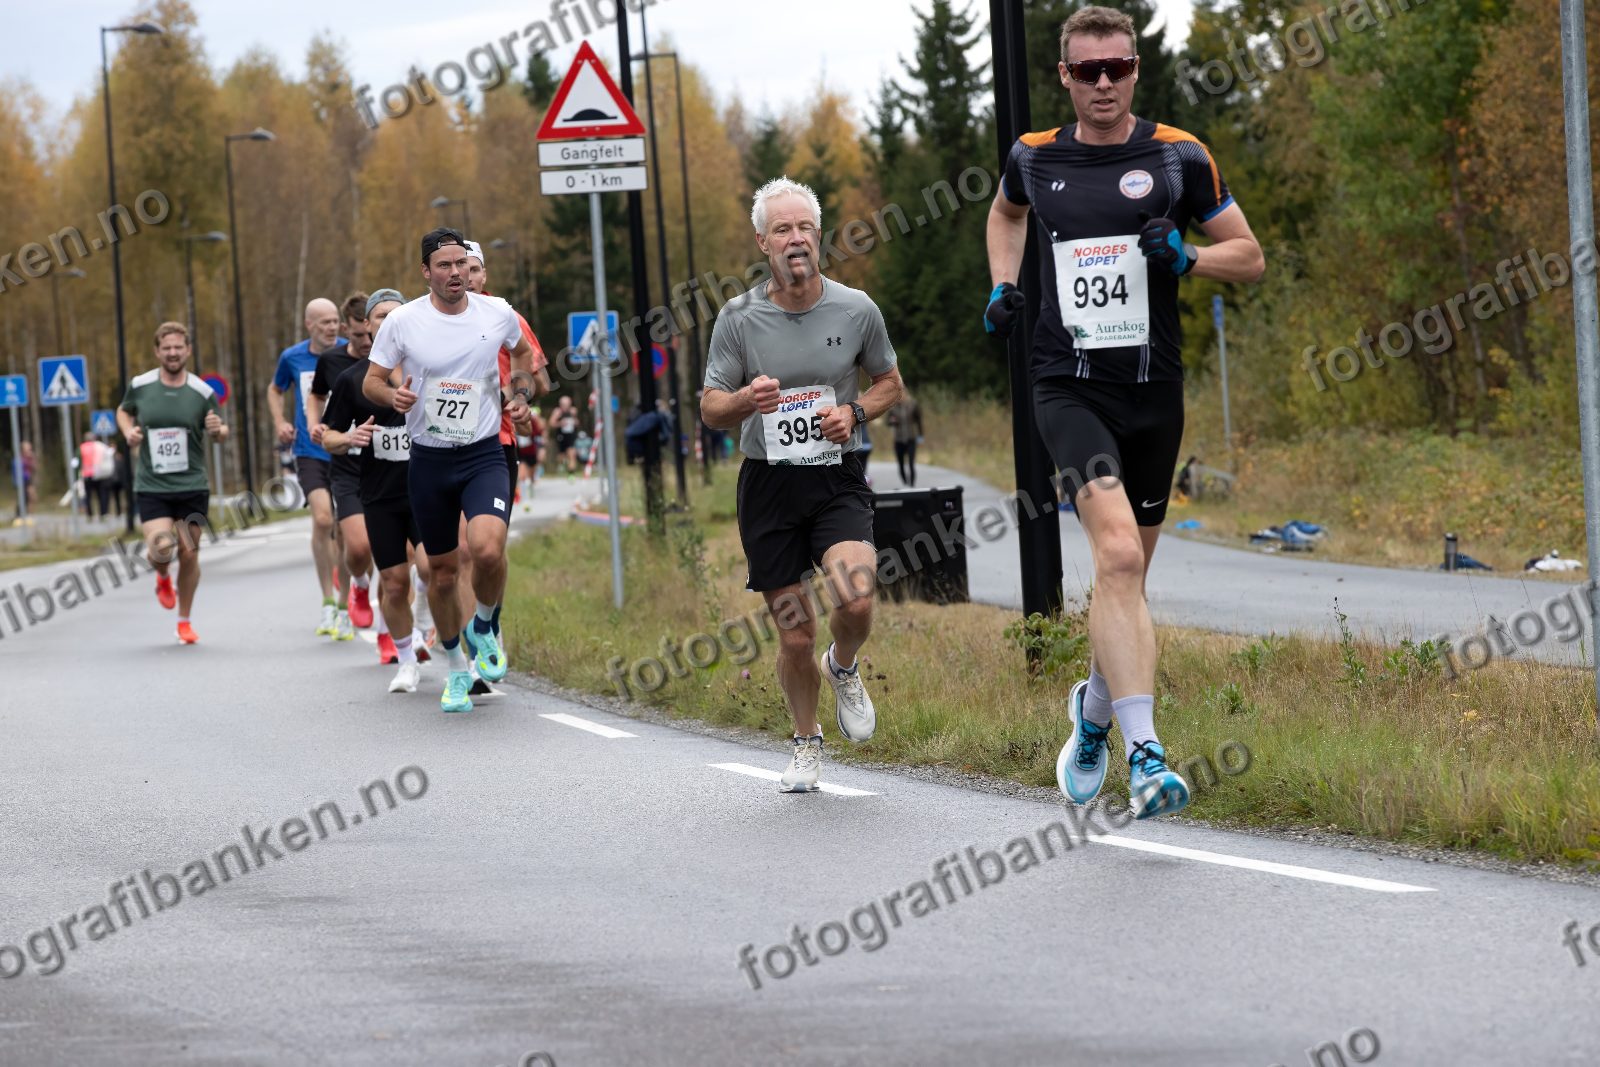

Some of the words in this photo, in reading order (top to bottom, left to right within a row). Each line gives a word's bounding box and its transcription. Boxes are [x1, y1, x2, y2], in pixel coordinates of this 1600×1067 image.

[560, 145, 624, 161] Gangfelt
[565, 175, 576, 188] 0
[590, 174, 597, 187] 1
[601, 174, 623, 186] km
[1073, 244, 1128, 258] NORGES
[1078, 255, 1119, 267] LØPET
[1073, 274, 1129, 309] 934
[1095, 321, 1146, 334] Aurskog
[439, 382, 472, 390] NORGES
[436, 398, 470, 420] 727
[781, 400, 815, 413] LØPET
[777, 416, 824, 446] 395
[381, 433, 411, 451] 813
[156, 442, 181, 457] 492
[800, 451, 839, 464] Aurskog
